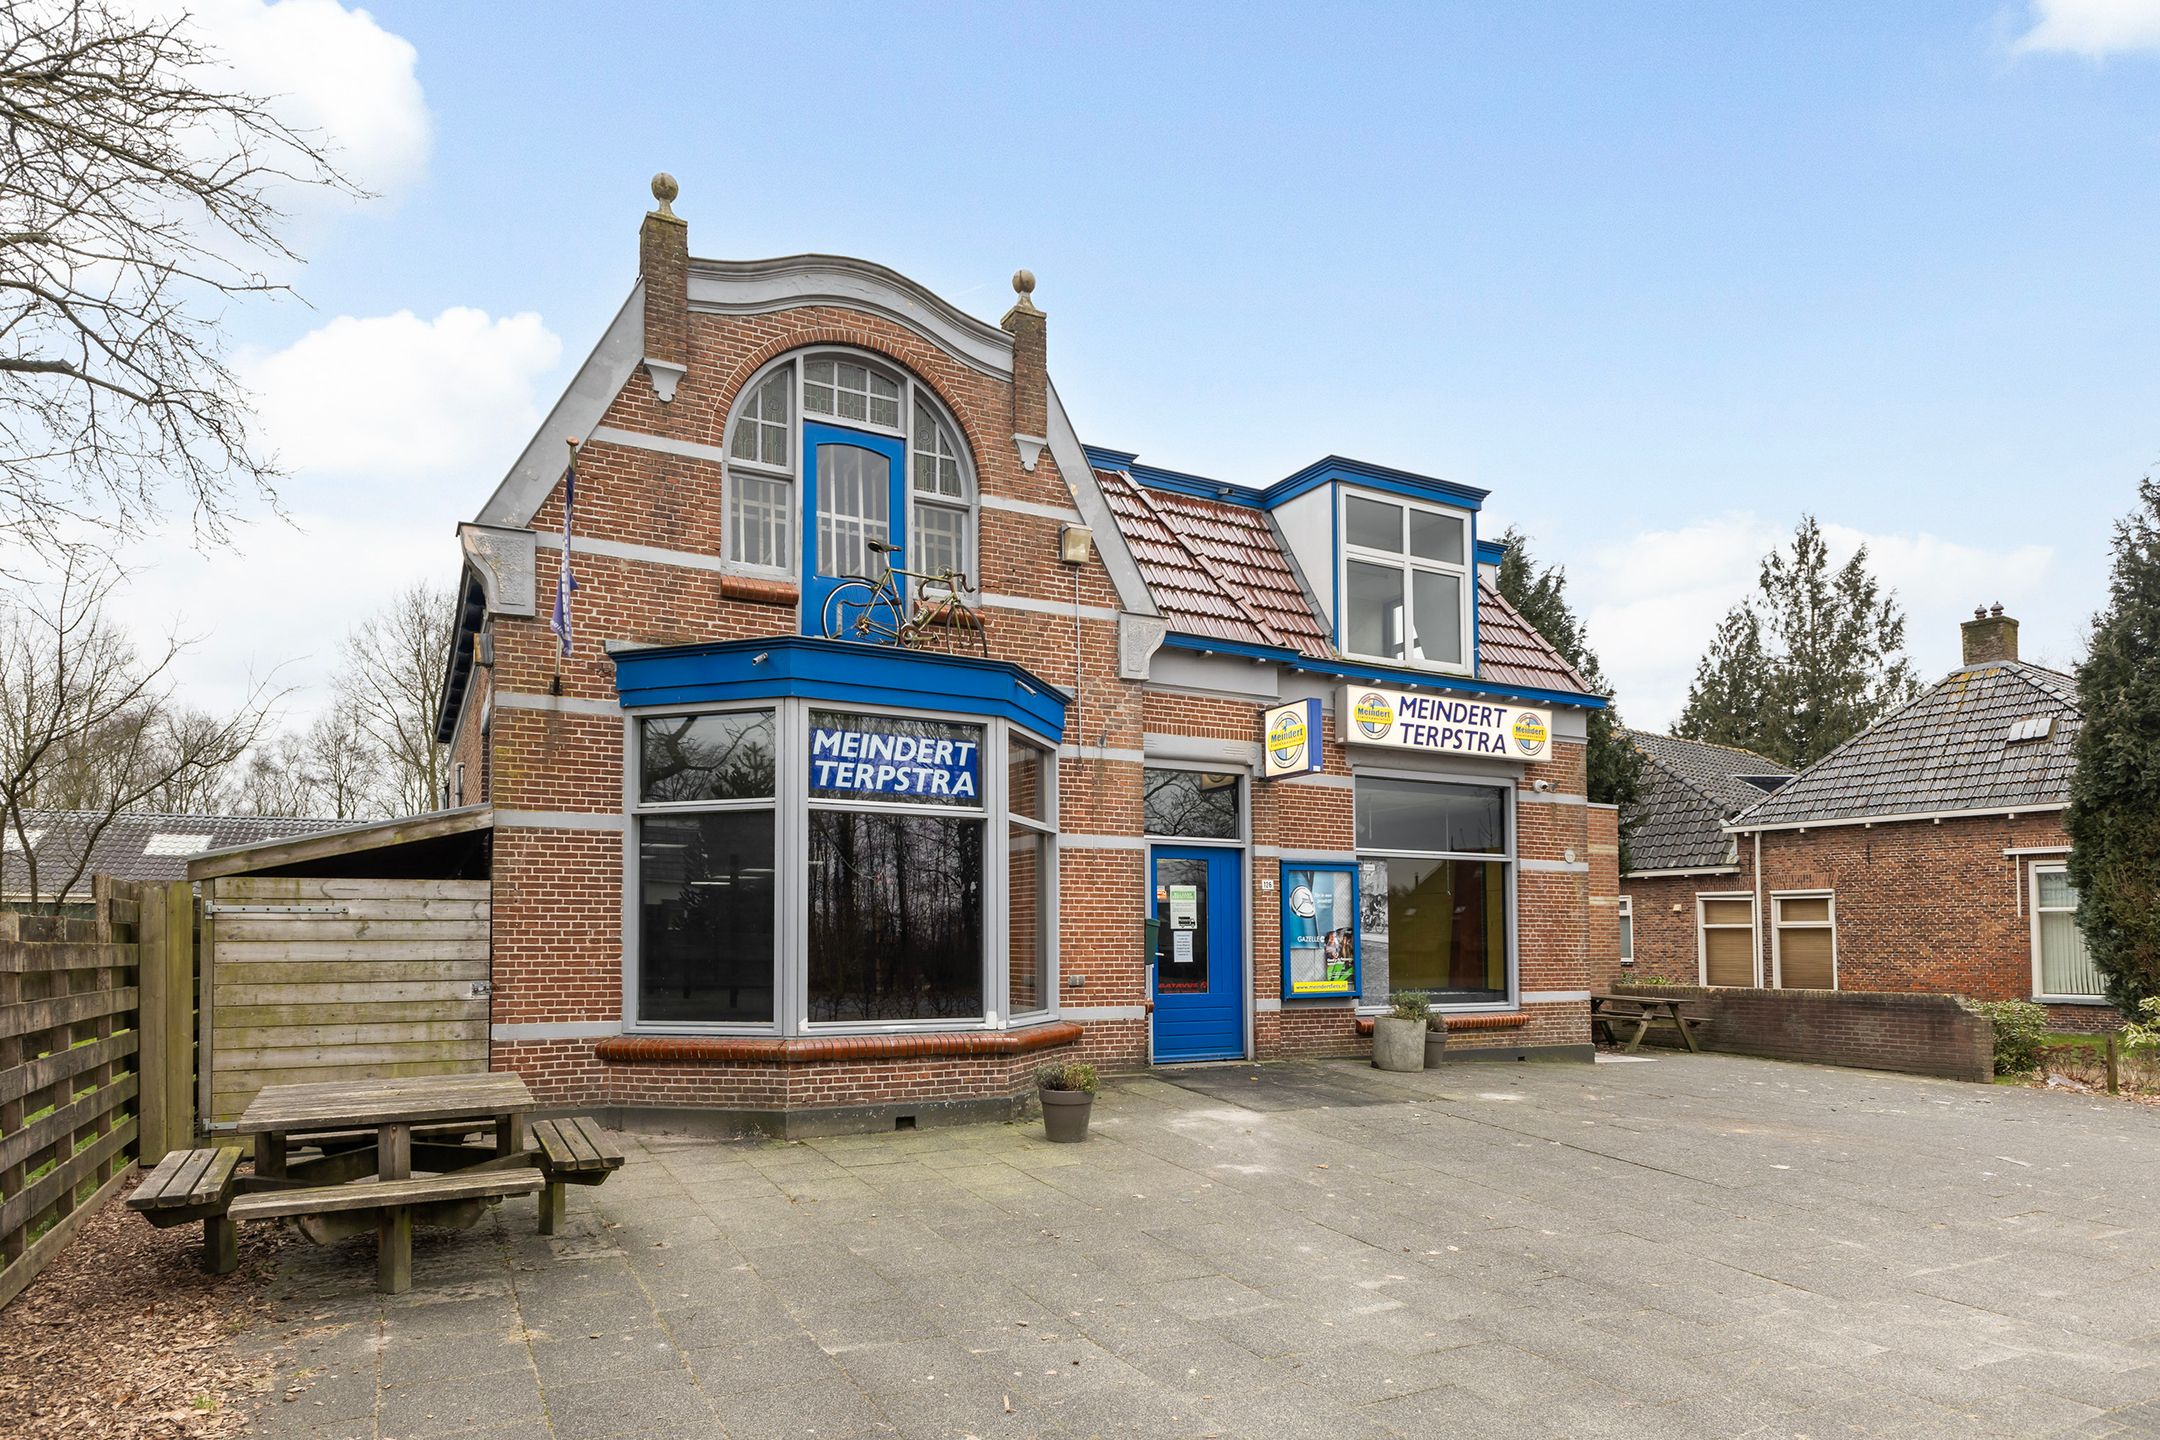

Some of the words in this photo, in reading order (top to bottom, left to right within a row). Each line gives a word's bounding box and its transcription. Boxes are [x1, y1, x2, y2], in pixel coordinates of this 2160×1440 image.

[1357, 707, 1391, 718] Meindert
[1398, 696, 1507, 728] MEINDERT
[1270, 728, 1303, 743] Meindert
[1400, 722, 1507, 754] TERPSTRA
[1515, 726, 1544, 735] Meindert
[812, 729, 976, 767] MEINDERT
[814, 760, 976, 797] TERPSTRA
[1263, 881, 1272, 889] 126
[1297, 935, 1320, 943] GAZELLE
